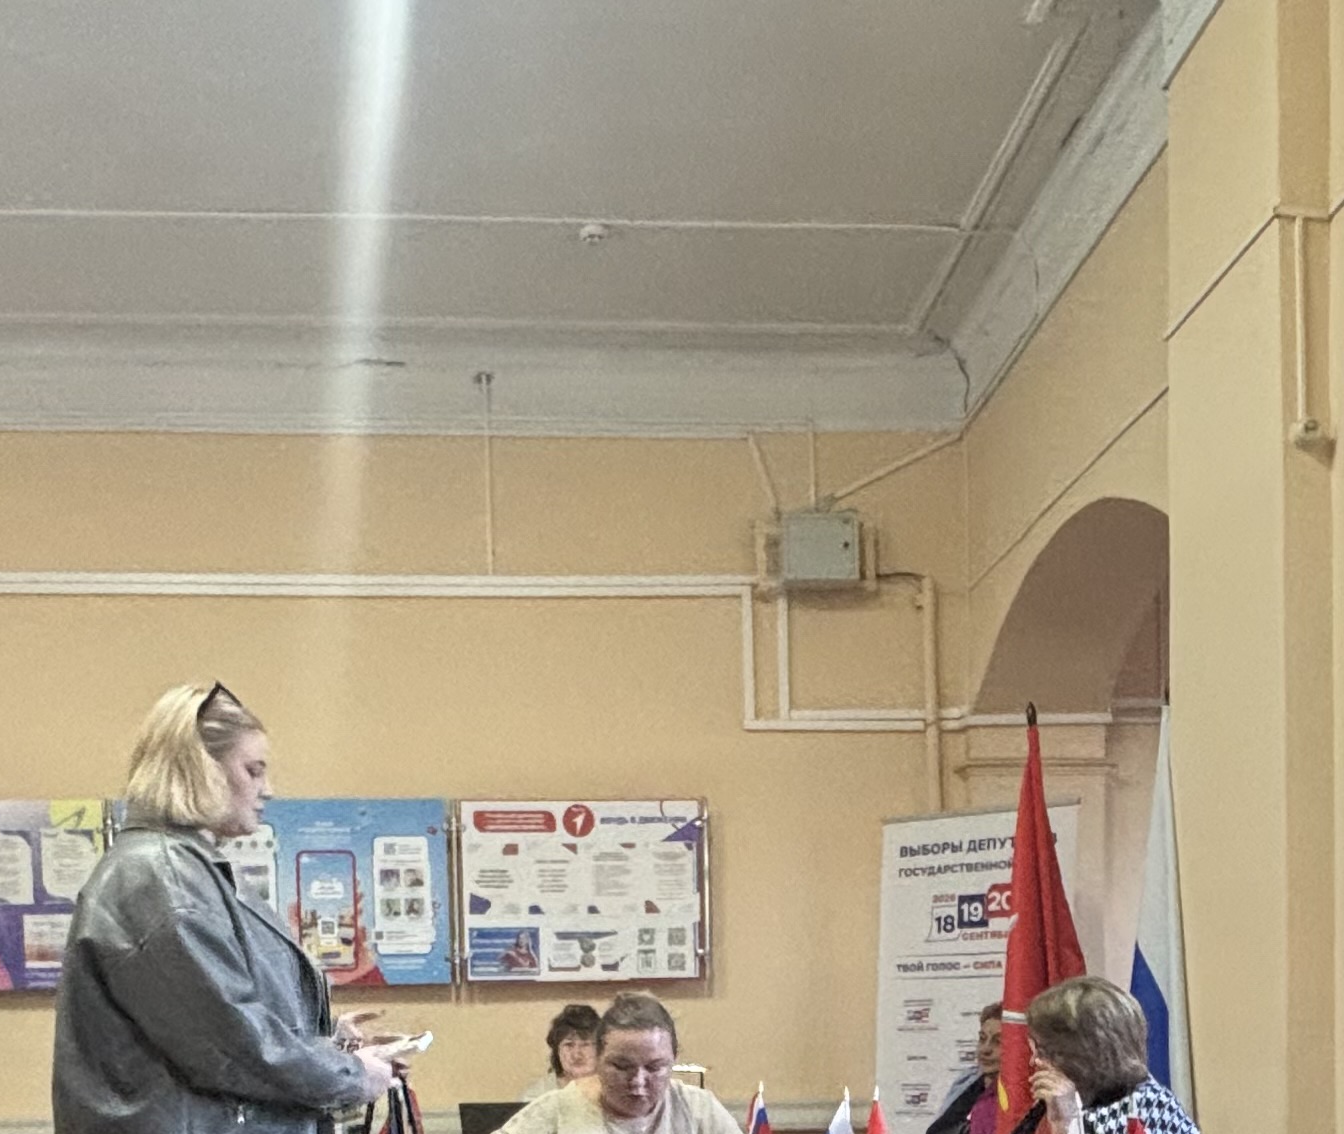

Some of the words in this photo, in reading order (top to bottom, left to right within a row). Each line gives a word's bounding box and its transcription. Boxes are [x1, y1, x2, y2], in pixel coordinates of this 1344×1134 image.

[899, 840, 964, 859] ВЫБОРЫ
[960, 901, 984, 923] 19
[934, 914, 956, 934] 18
[896, 960, 924, 973] ТВОЙ
[926, 961, 961, 972] ГОЛОС
